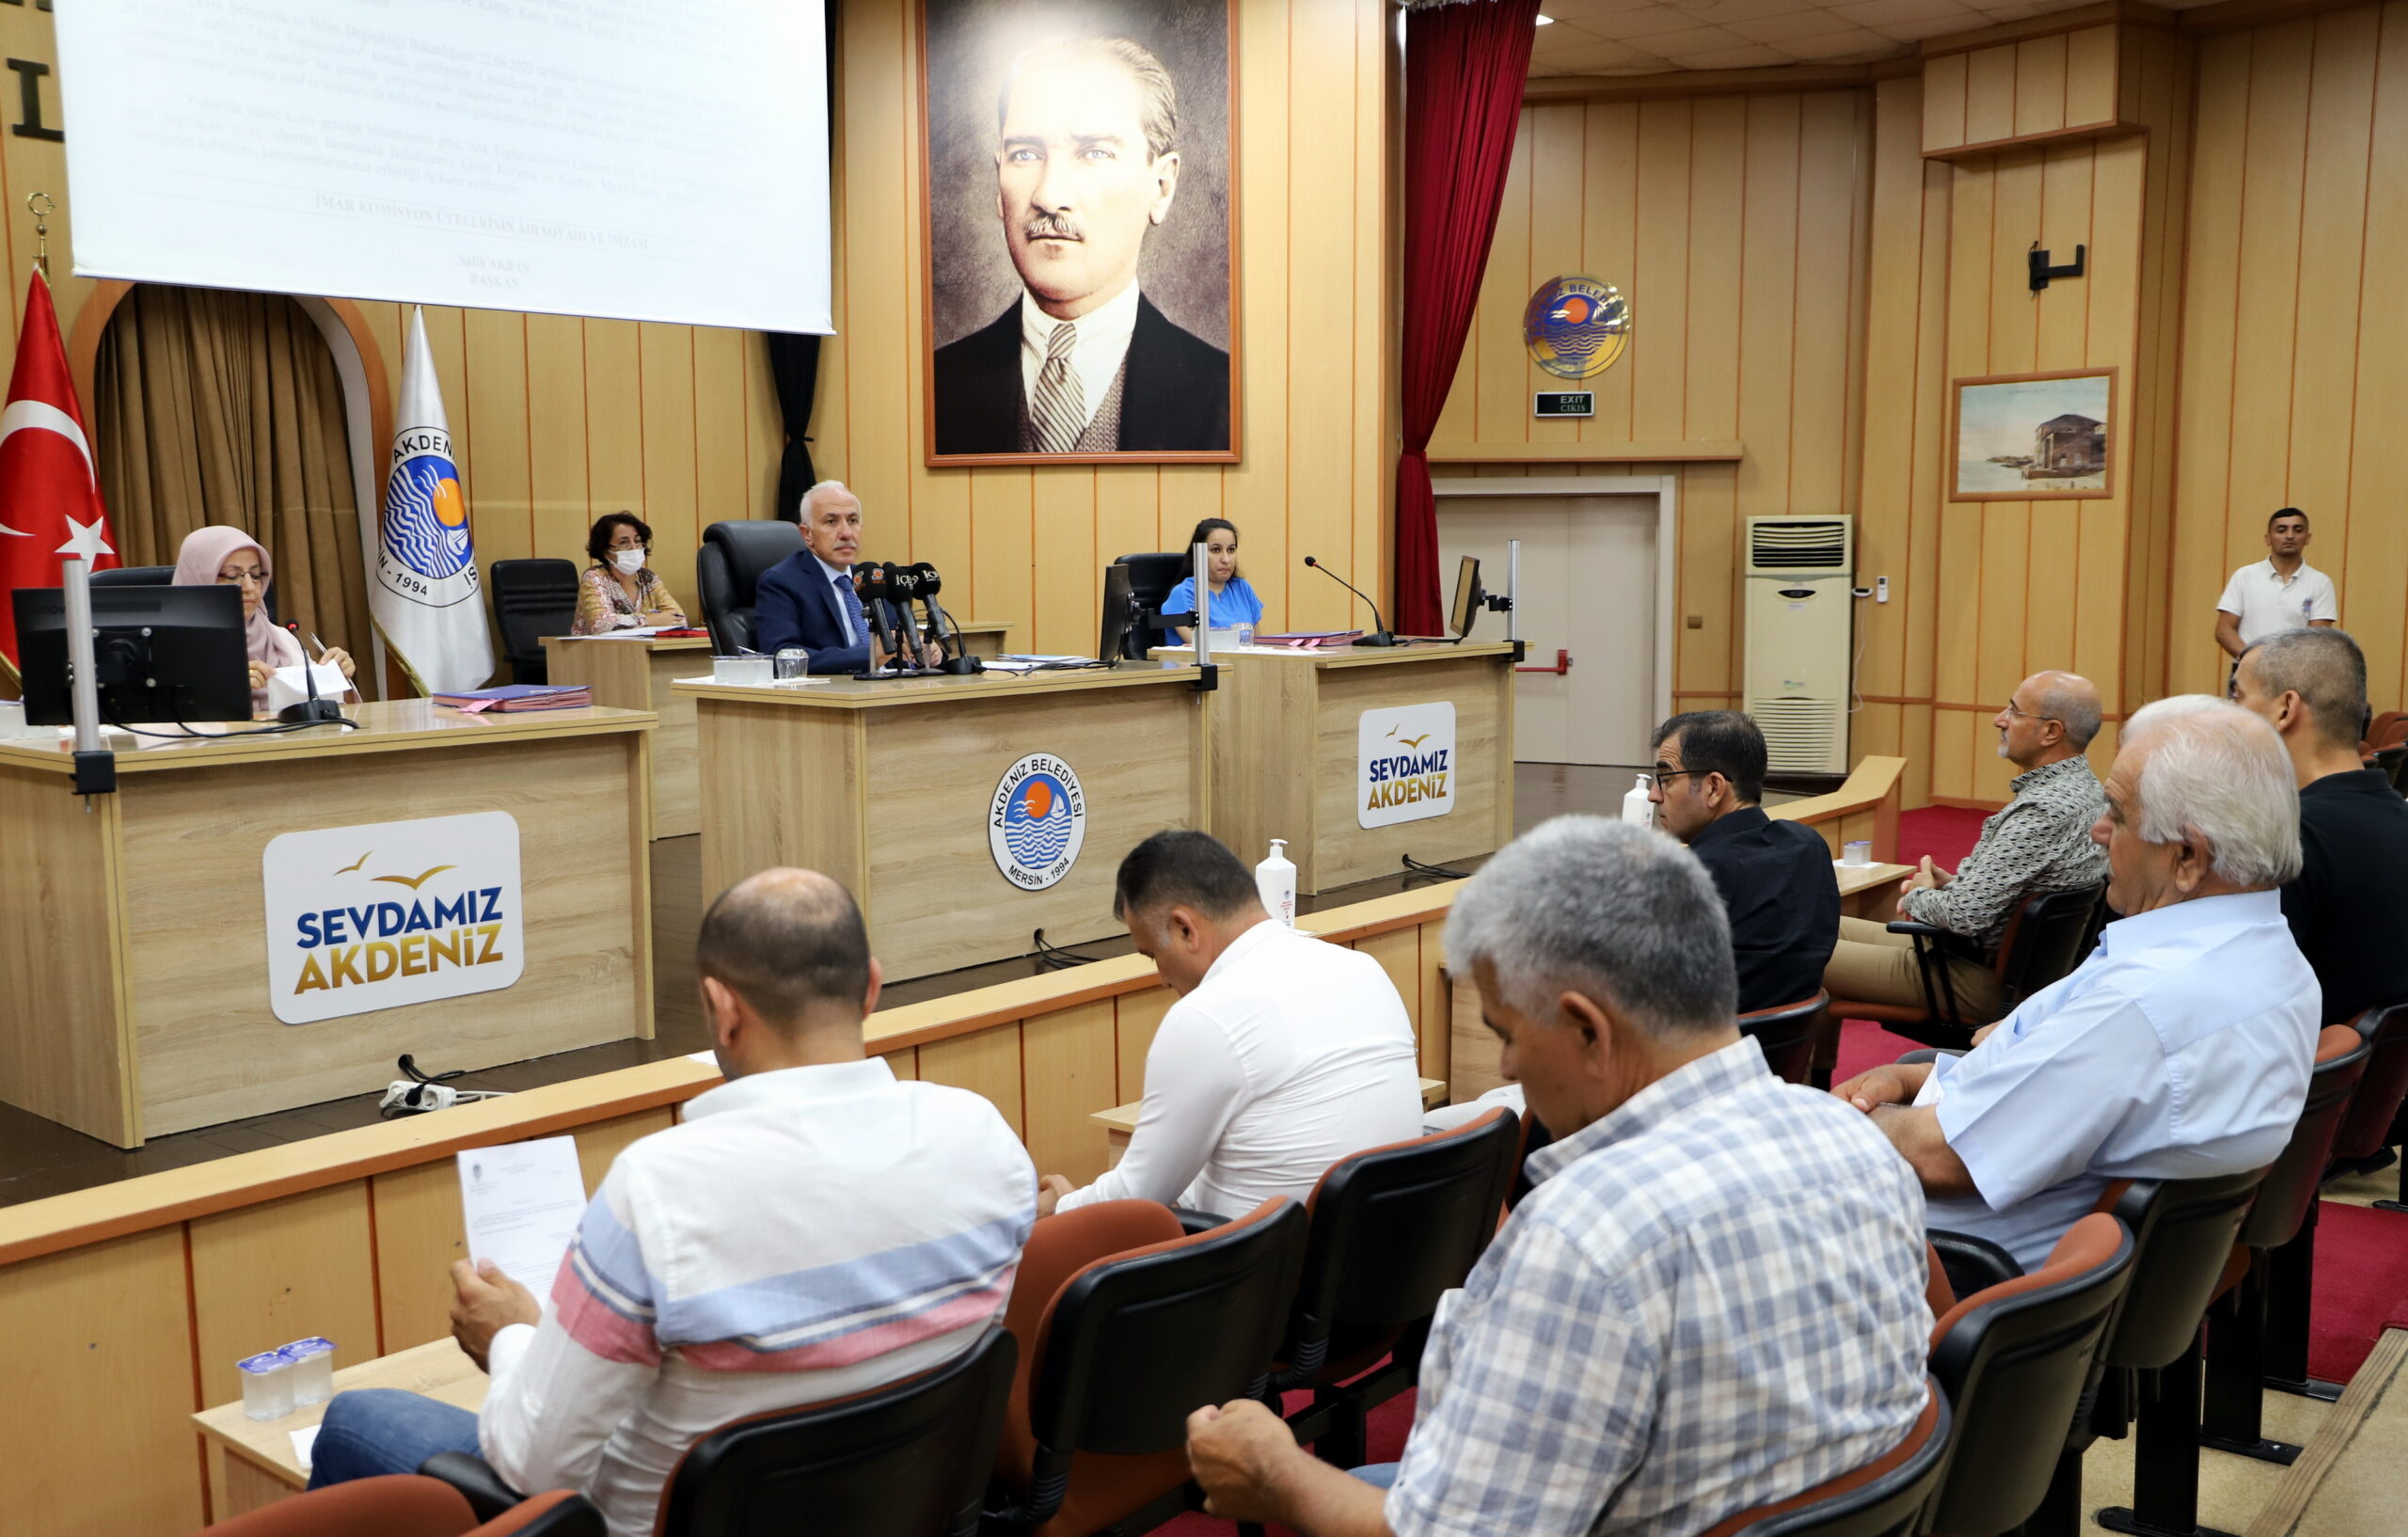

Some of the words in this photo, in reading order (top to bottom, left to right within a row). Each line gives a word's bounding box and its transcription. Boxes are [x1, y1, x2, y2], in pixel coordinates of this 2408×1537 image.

[1560, 395, 1585, 404] EXIT
[393, 435, 455, 464] AKDEN
[395, 573, 428, 596] 1994
[1369, 749, 1449, 783] SEVDAMIZ
[993, 763, 1028, 829] AKDENİZ
[1031, 758, 1085, 817] BELEDİYESİ
[1367, 772, 1448, 811] AKDENİZ
[1008, 864, 1043, 885] MERSİN
[1050, 857, 1069, 879] 1994
[296, 886, 503, 949] SEVDAMIZ
[293, 923, 503, 995] AKDENİZ
